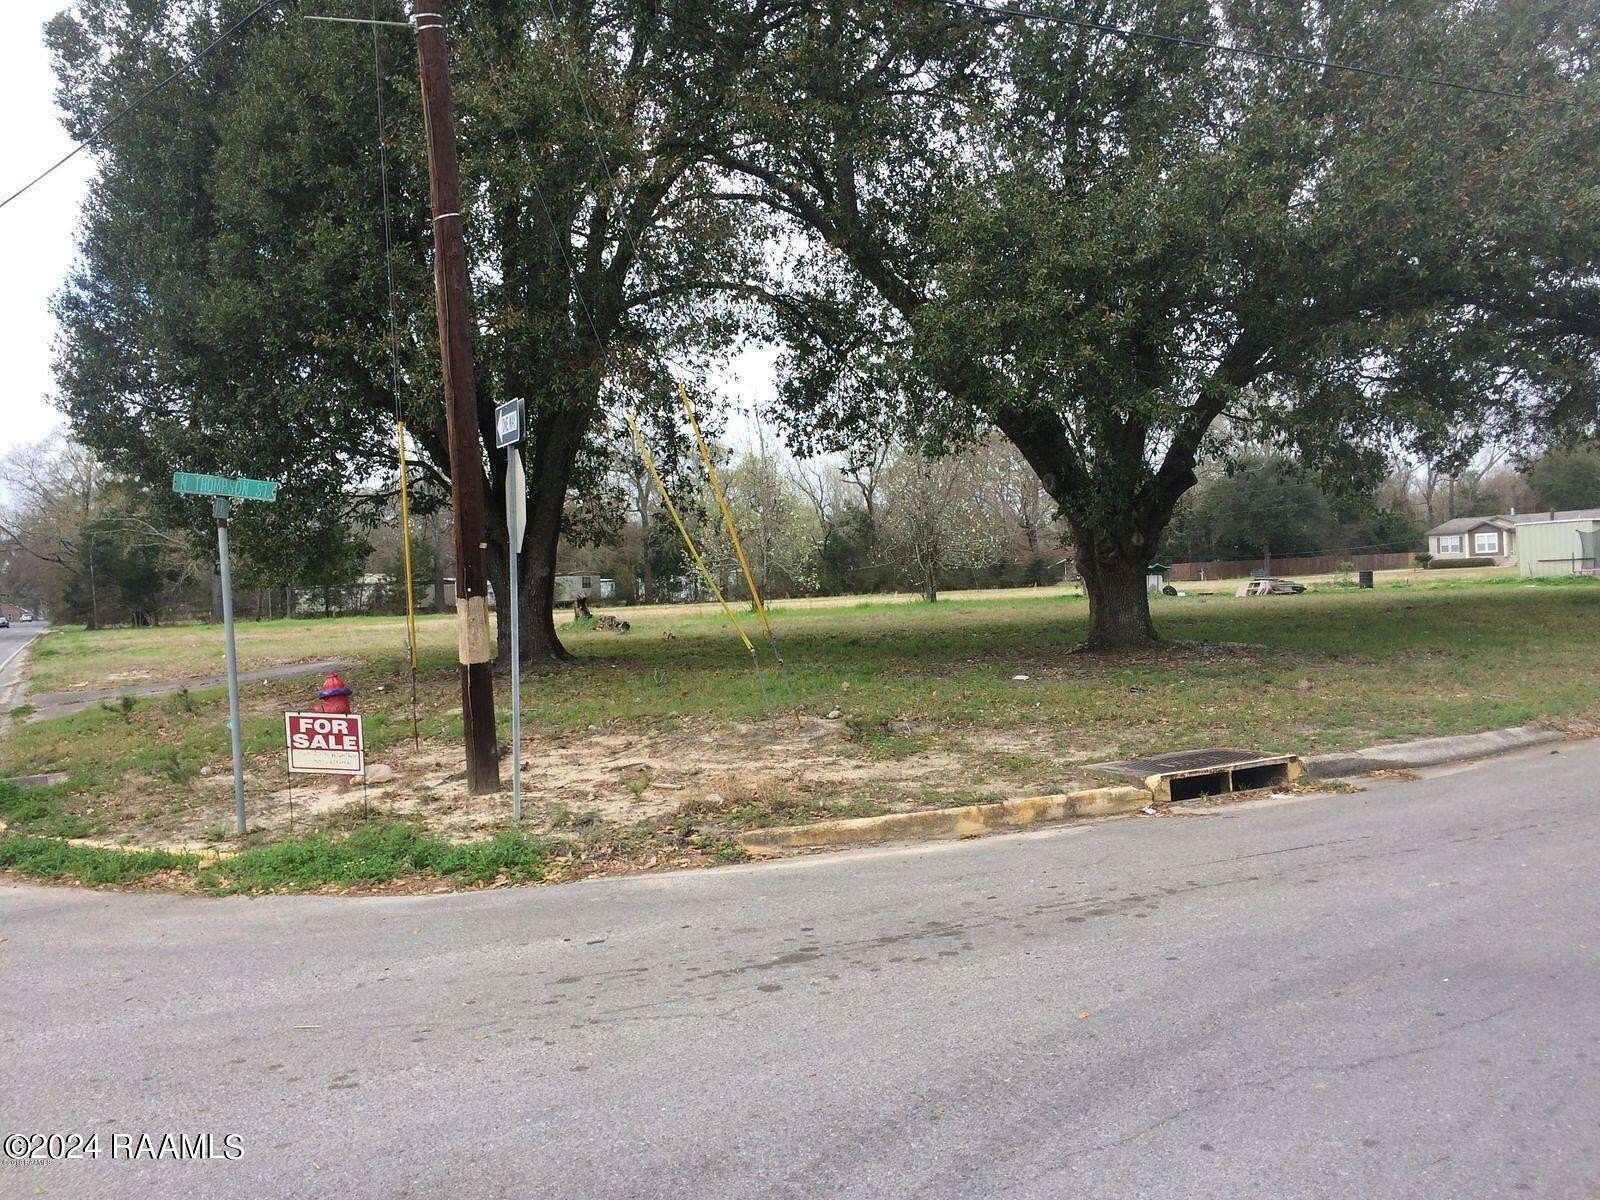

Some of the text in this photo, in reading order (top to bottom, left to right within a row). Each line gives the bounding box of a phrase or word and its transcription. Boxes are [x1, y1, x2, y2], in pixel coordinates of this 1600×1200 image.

[195, 476, 250, 497] THOMPSON
[299, 718, 349, 735] FOR
[292, 733, 358, 750] SALE
